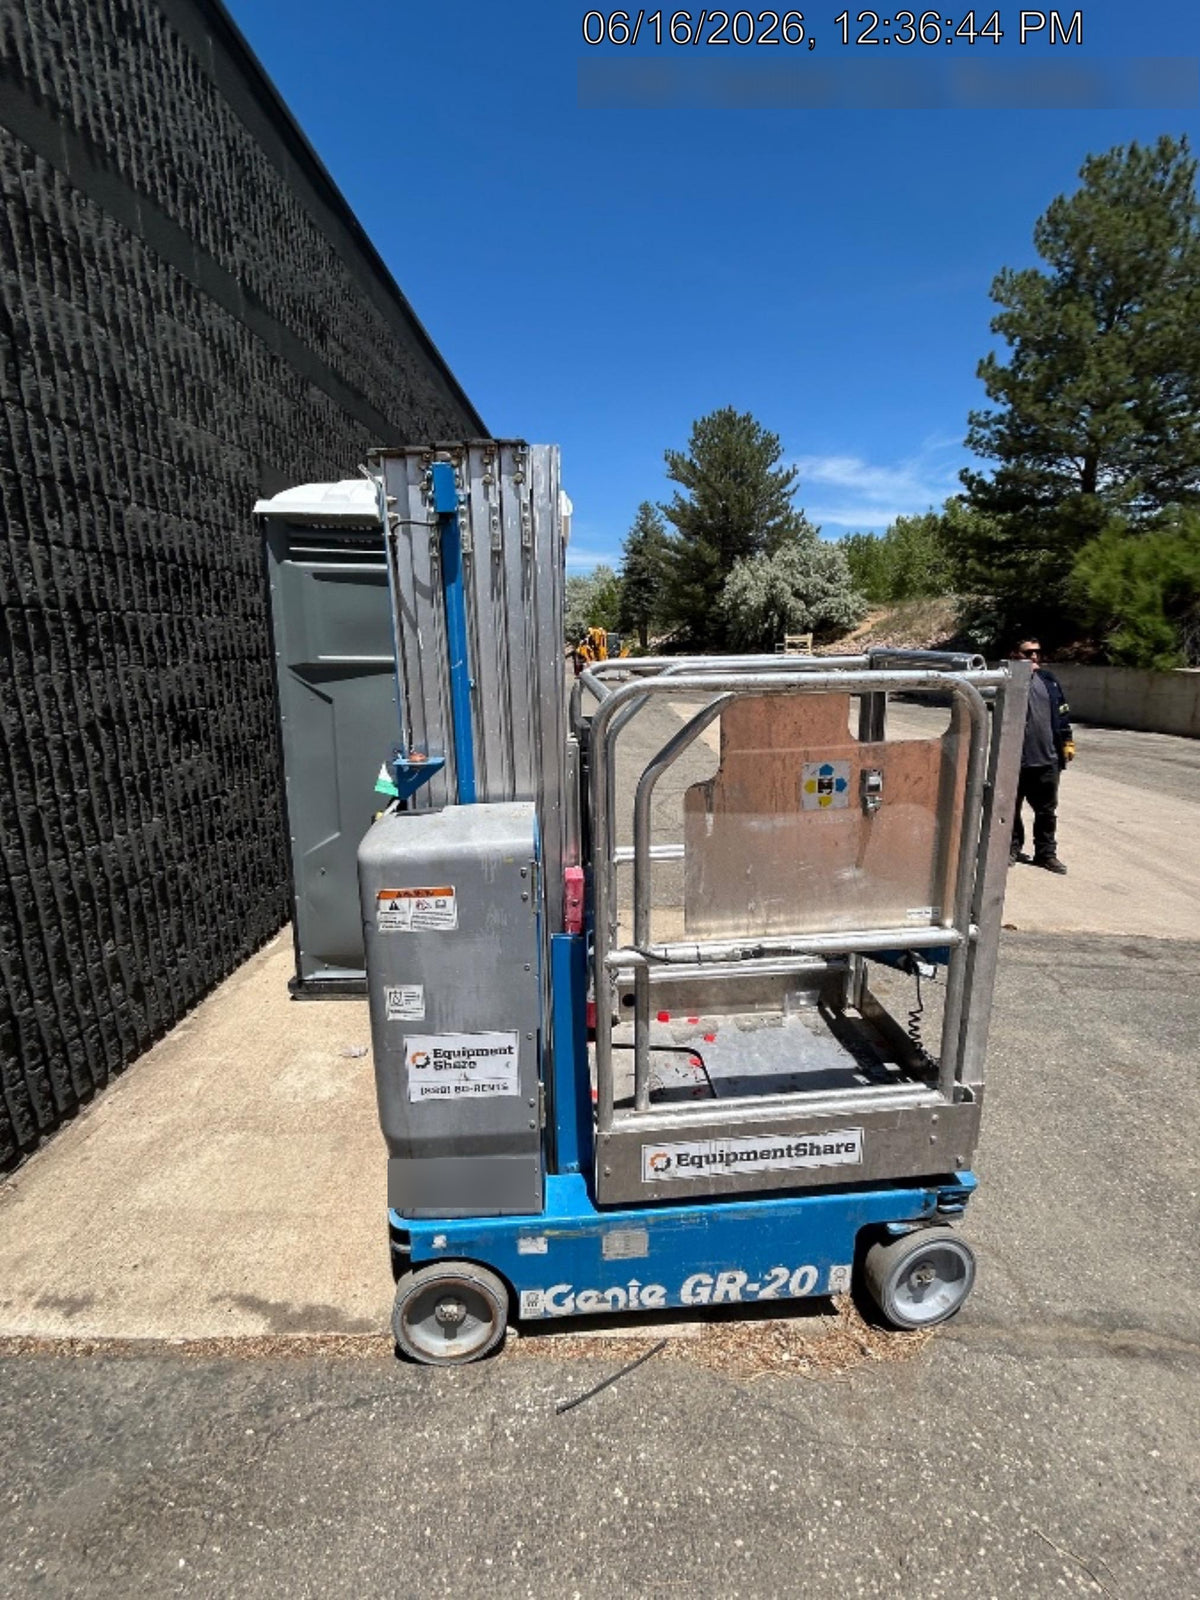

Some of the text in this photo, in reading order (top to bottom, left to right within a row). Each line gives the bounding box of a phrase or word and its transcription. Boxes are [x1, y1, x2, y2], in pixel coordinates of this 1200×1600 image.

[433, 1045, 514, 1060] Equipment
[433, 1060, 477, 1071] Share
[676, 1142, 856, 1168] EquipmentShare
[543, 1265, 819, 1316] Genie GR-20
